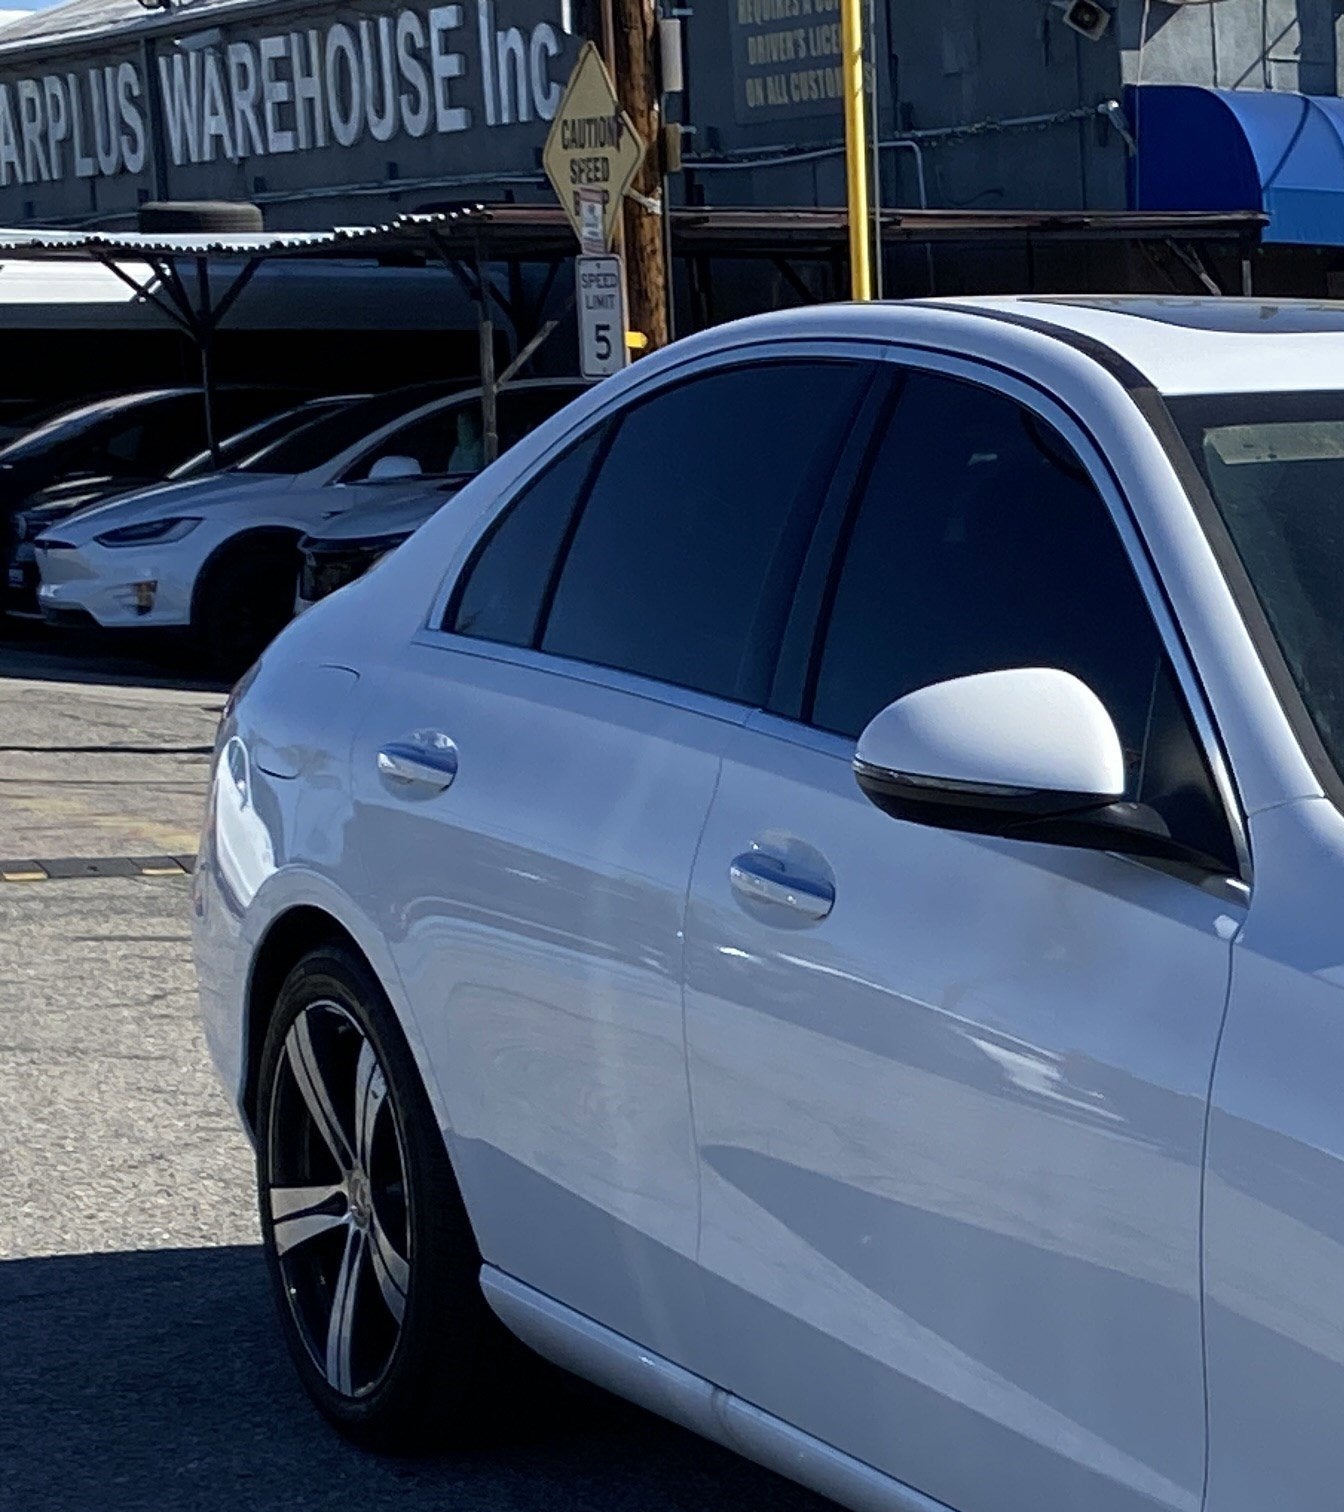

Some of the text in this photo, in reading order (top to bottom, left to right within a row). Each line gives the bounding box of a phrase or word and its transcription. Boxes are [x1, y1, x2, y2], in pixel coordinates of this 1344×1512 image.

[157, 4, 471, 166] WAREHOUSE
[744, 77, 765, 108] ON
[765, 73, 790, 105] ALL
[561, 115, 619, 150] CAUTION
[570, 157, 609, 185] SPEED
[581, 272, 618, 289] SPEED
[585, 293, 615, 310] LIMIT
[594, 323, 612, 361] 5
